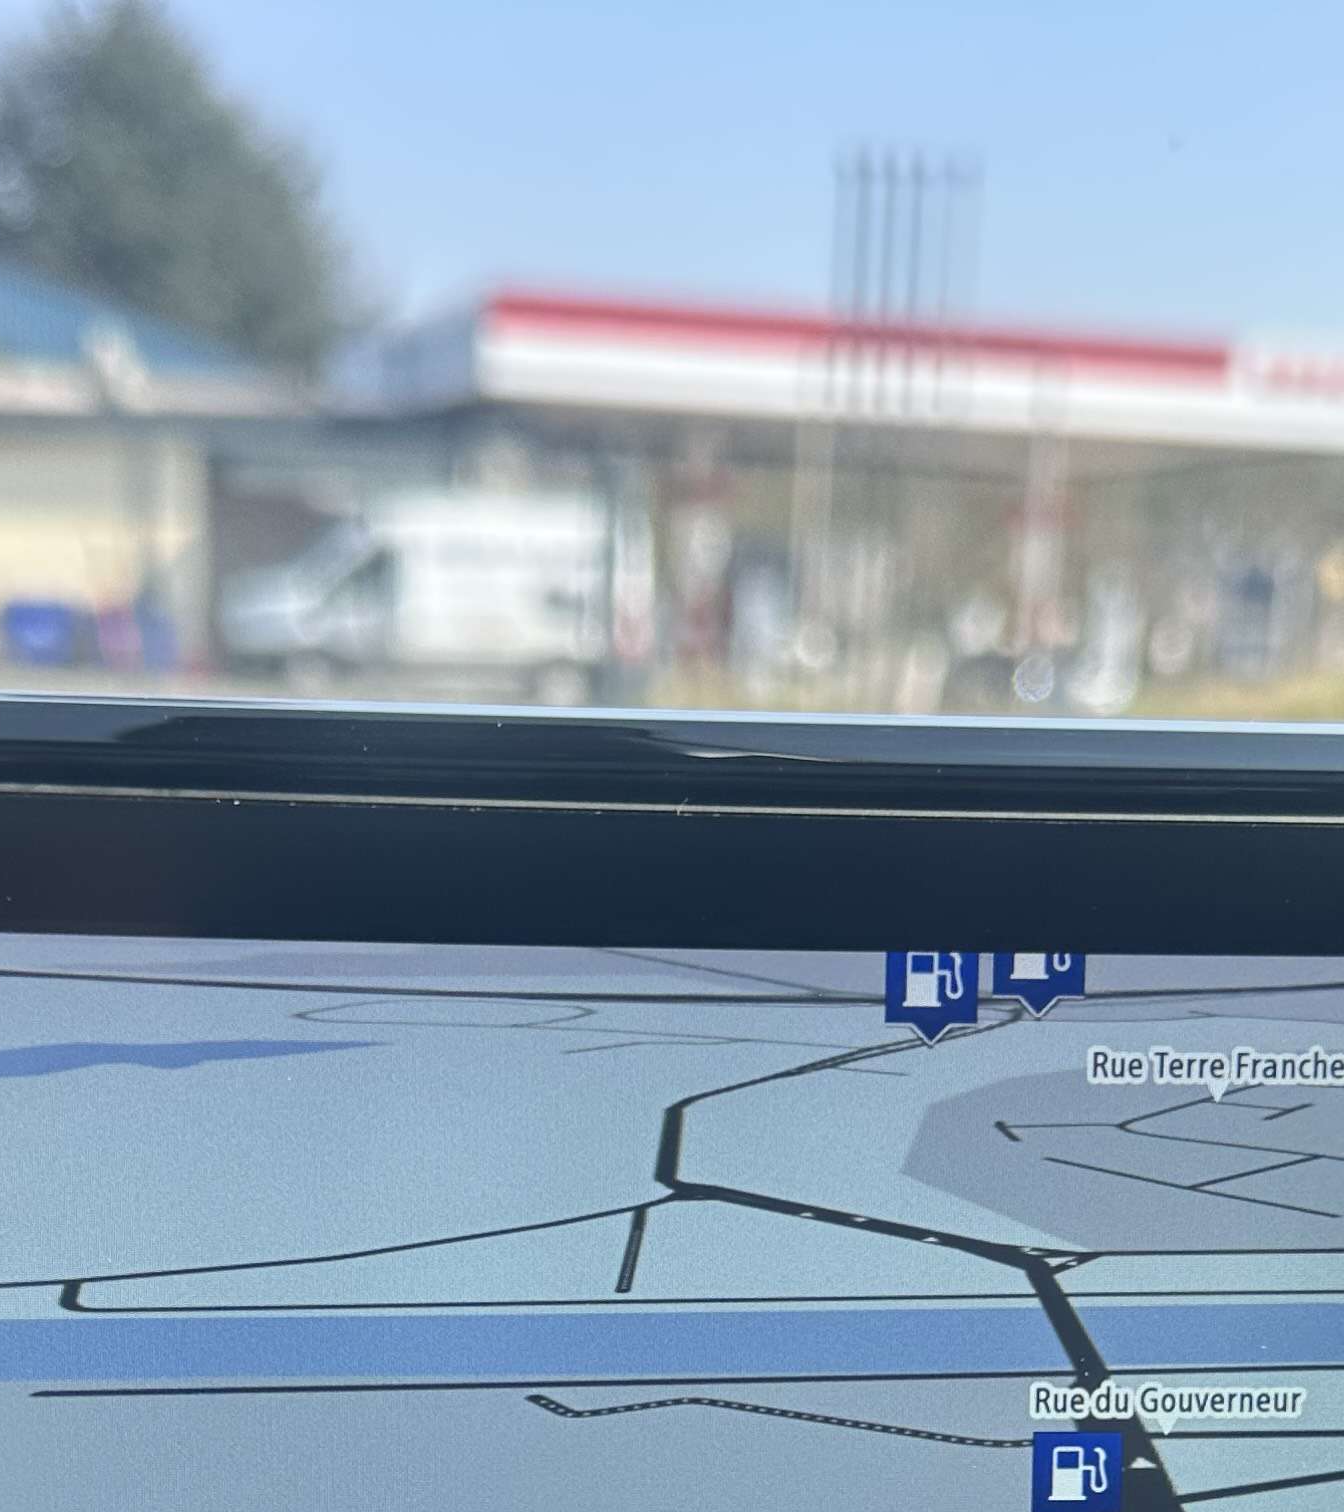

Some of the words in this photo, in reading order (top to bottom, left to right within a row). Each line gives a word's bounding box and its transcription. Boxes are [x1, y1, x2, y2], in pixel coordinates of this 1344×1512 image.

[1092, 1051, 1144, 1079] Rue
[1154, 1052, 1225, 1079] Terre
[1035, 1387, 1085, 1414] Rue
[1094, 1385, 1130, 1414] du
[1140, 1386, 1303, 1414] Gouverneur
